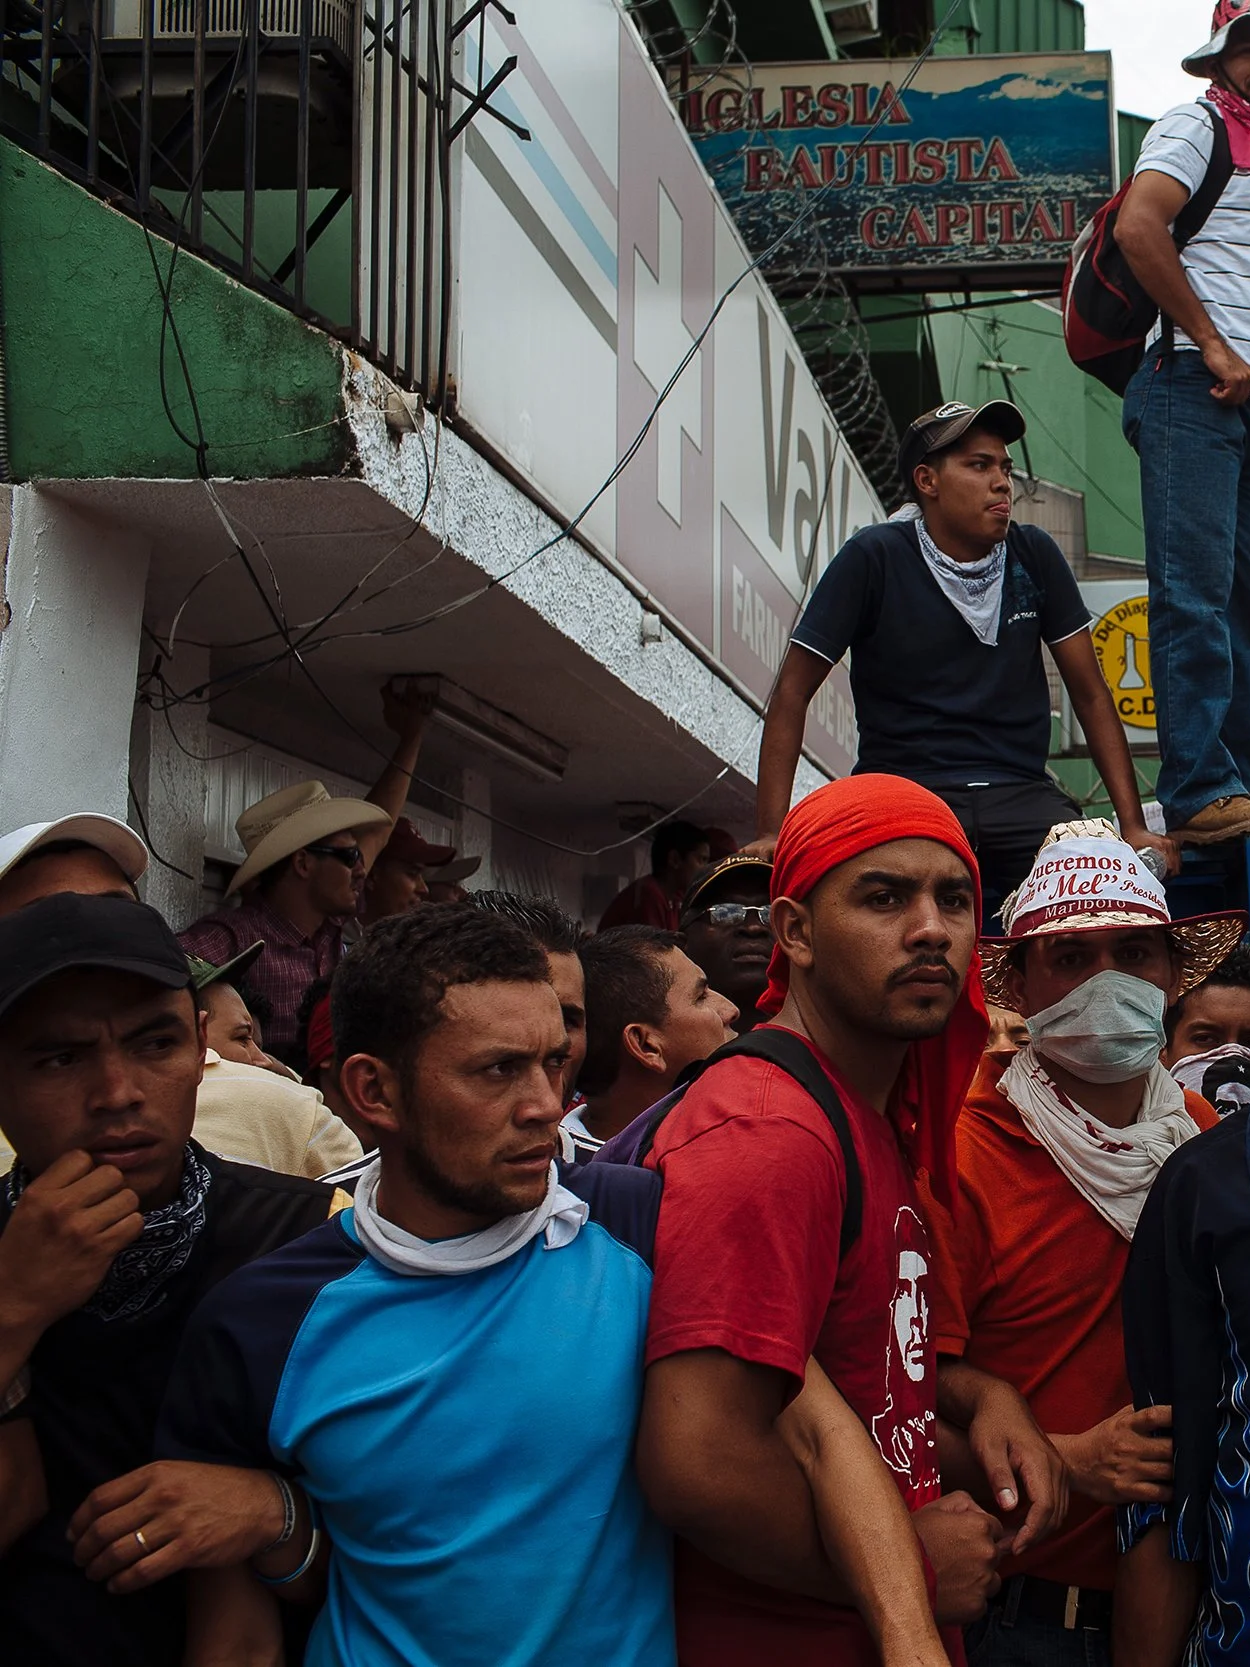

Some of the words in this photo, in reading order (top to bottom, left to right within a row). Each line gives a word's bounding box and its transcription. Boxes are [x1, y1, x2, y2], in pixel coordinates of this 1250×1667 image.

[685, 80, 911, 134] IGLESIA
[744, 136, 1020, 192] BAUTISTA
[1127, 862, 1138, 876] a
[1044, 900, 1126, 920] Marlboro
